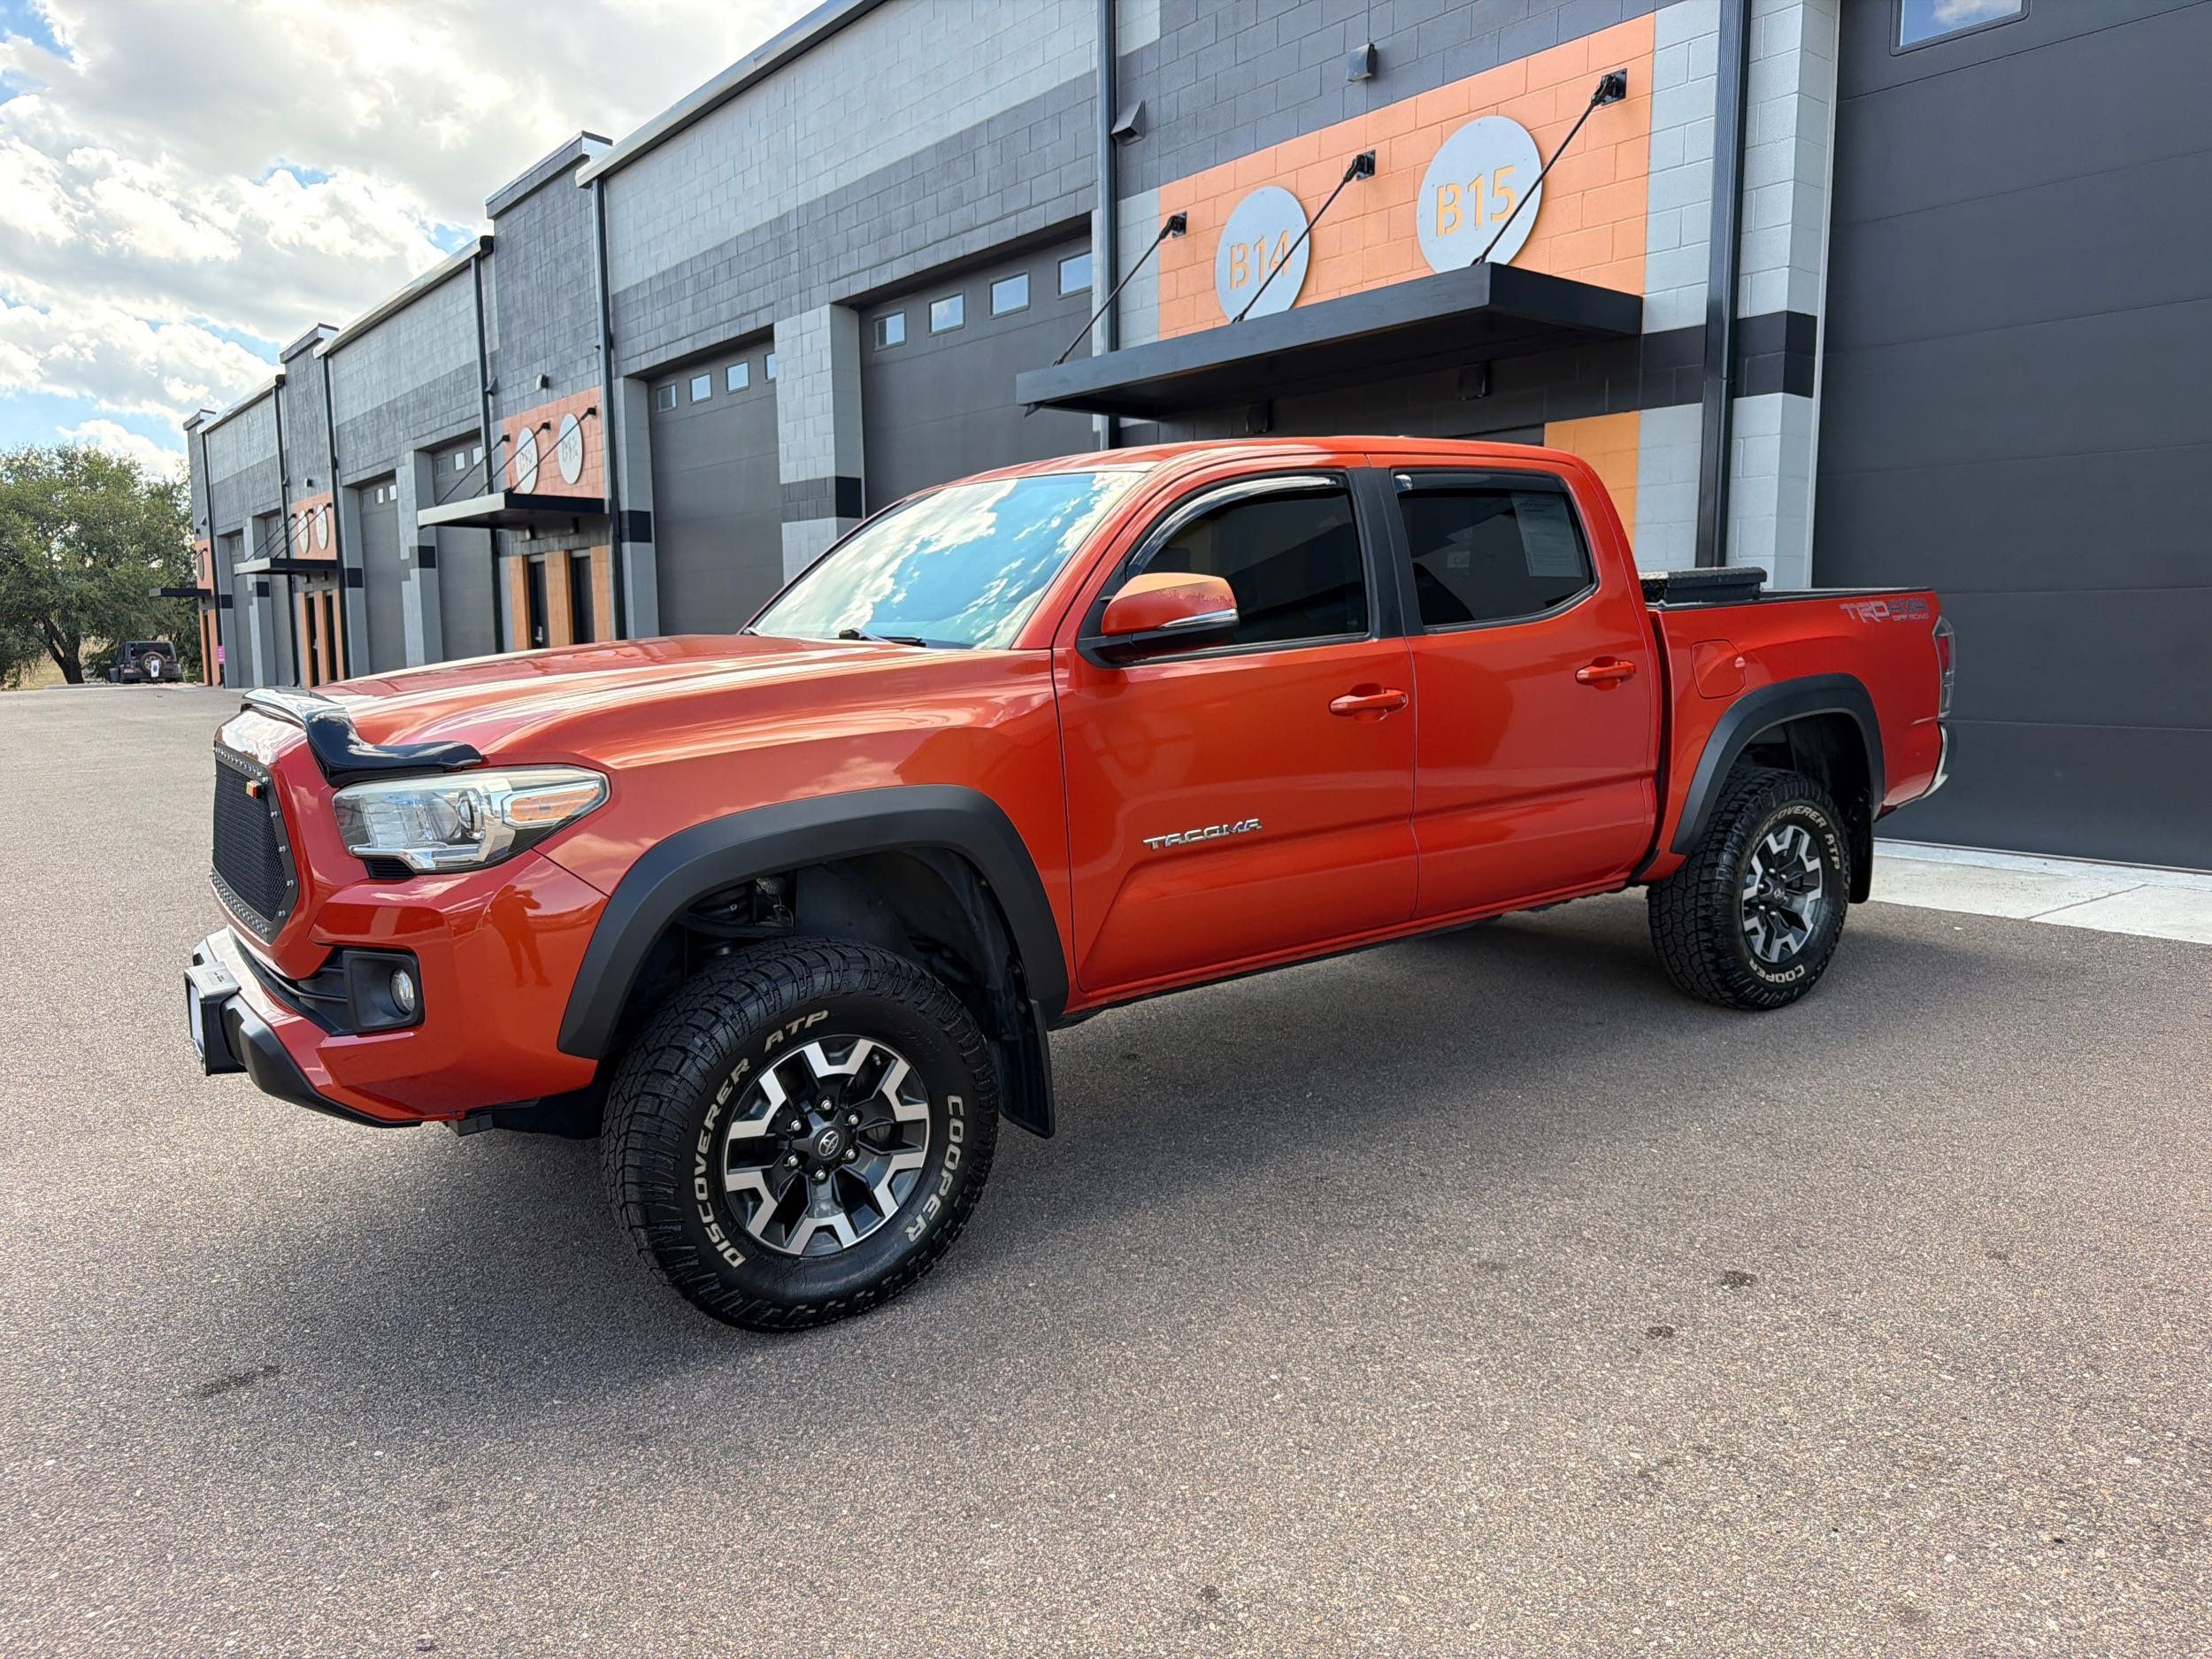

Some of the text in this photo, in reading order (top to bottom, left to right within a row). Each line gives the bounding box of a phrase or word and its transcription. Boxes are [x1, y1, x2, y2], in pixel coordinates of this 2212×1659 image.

[1436, 165, 1516, 237] B15
[1230, 229, 1293, 290] B14
[1839, 601, 1890, 623] TRD
[1142, 818, 1263, 849] TACOMA
[1824, 833, 1840, 870] ATP
[1749, 958, 1805, 983] COOPER
[695, 1010, 829, 1268] DISCOVERER ATP
[904, 1094, 964, 1242] COOPER
